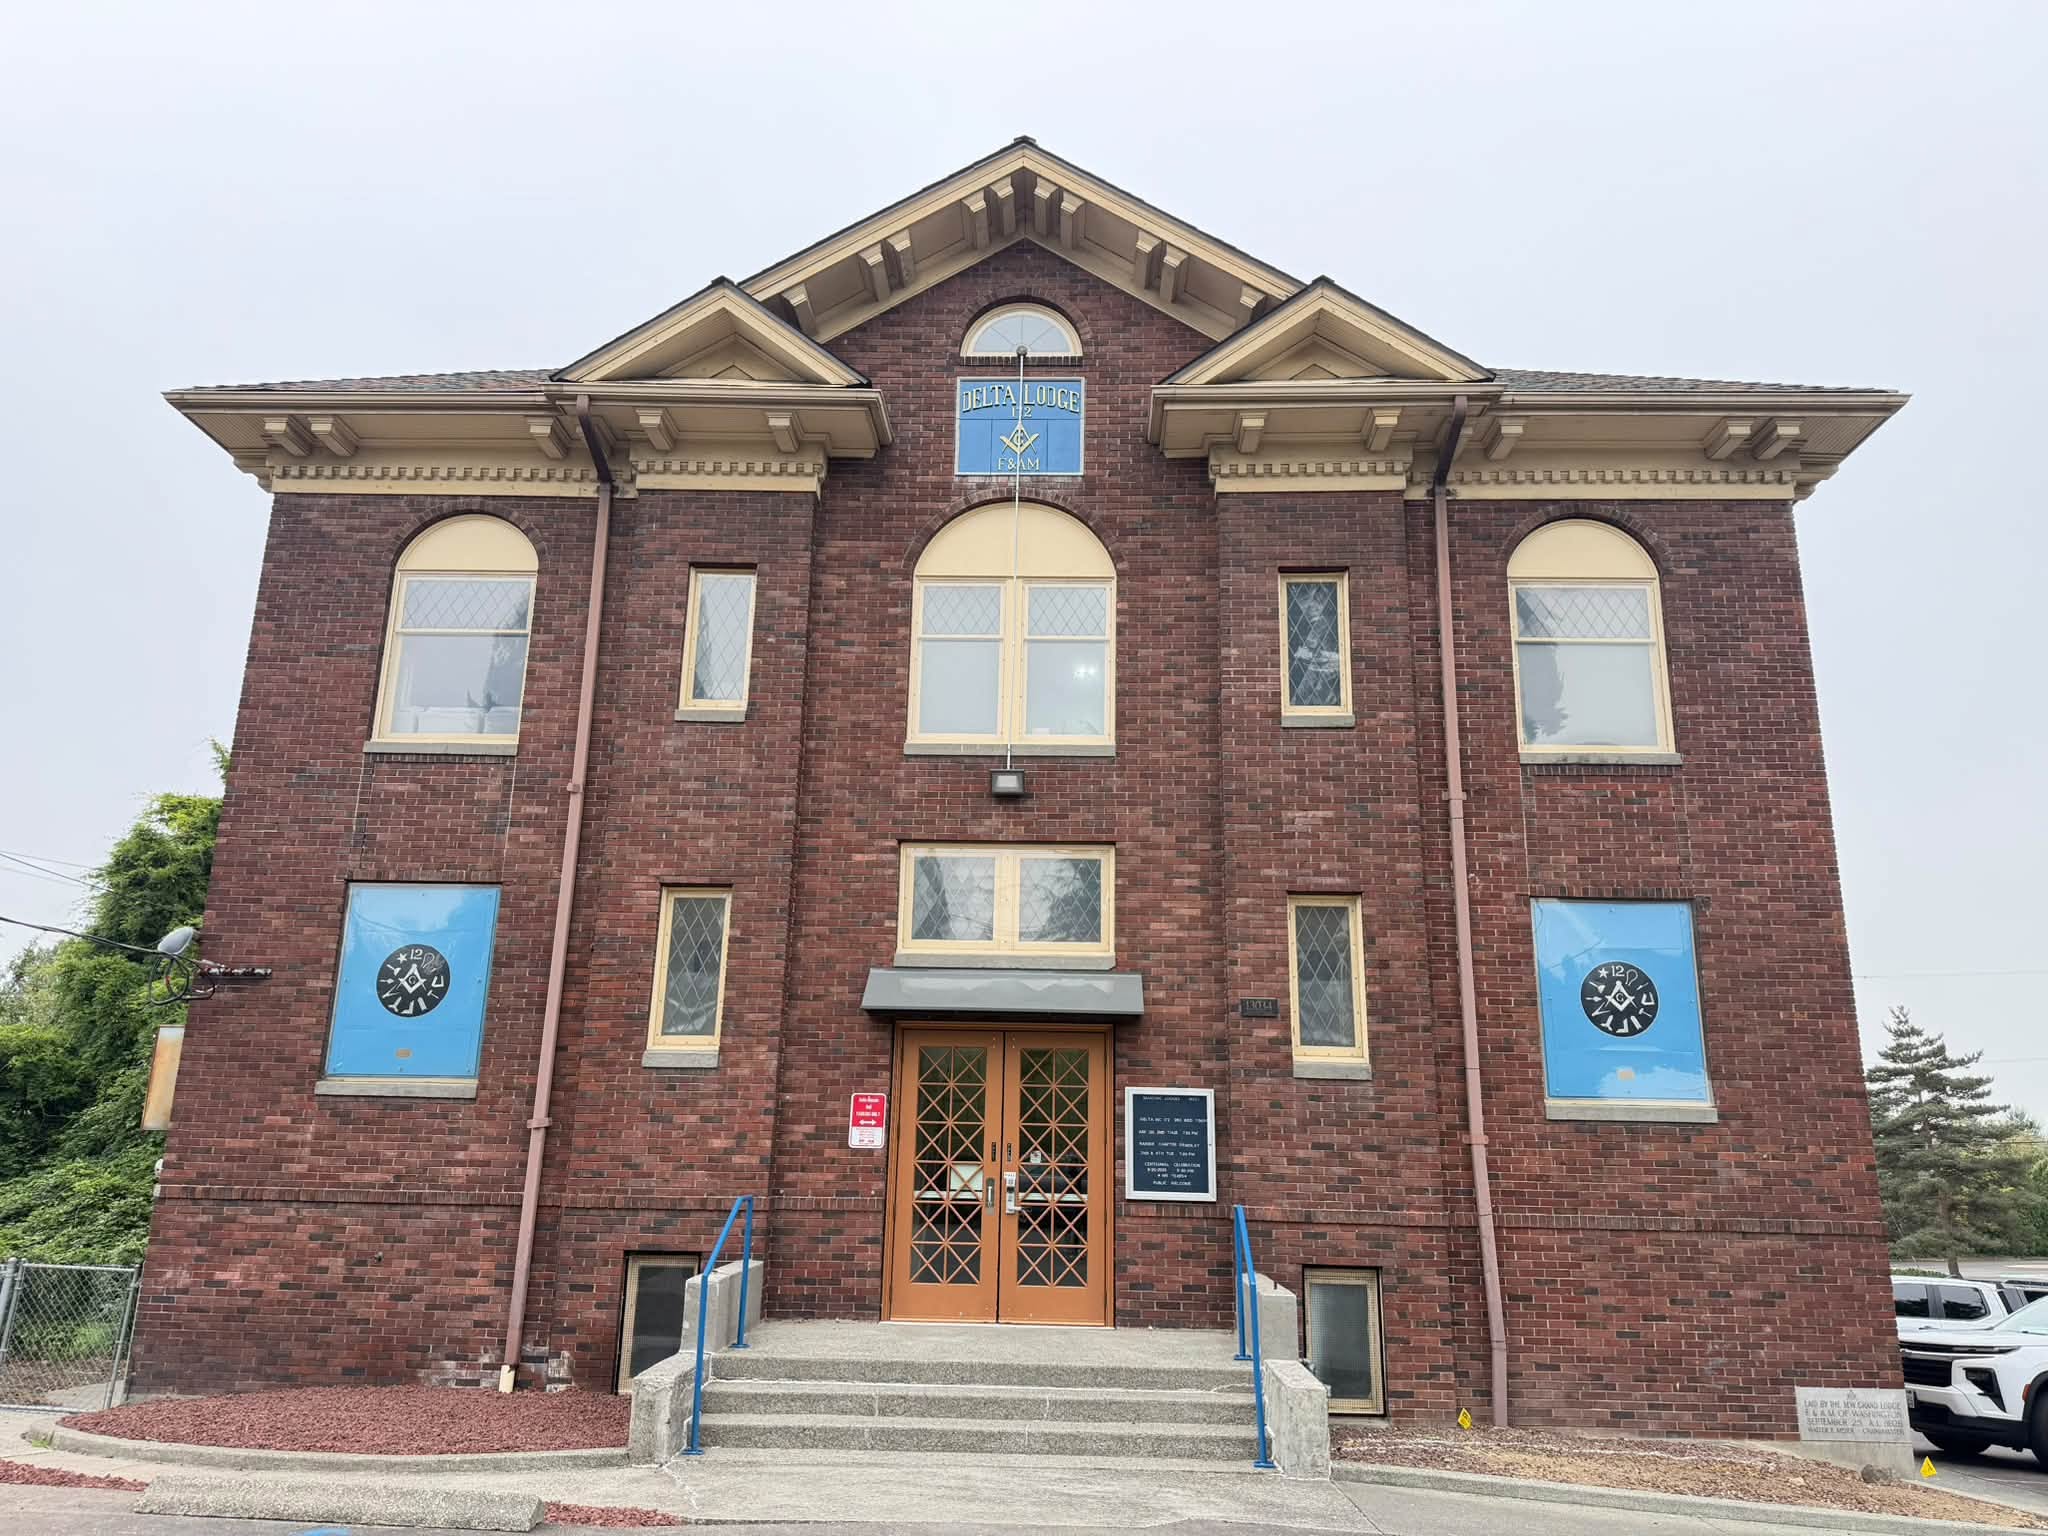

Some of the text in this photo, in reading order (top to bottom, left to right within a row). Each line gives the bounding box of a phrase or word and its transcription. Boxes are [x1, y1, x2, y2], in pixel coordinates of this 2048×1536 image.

[963, 383, 1080, 414] DELTA LODGE
[410, 949, 424, 960] 12
[1611, 965, 1625, 977] 12
[1615, 992, 1625, 1002] G
